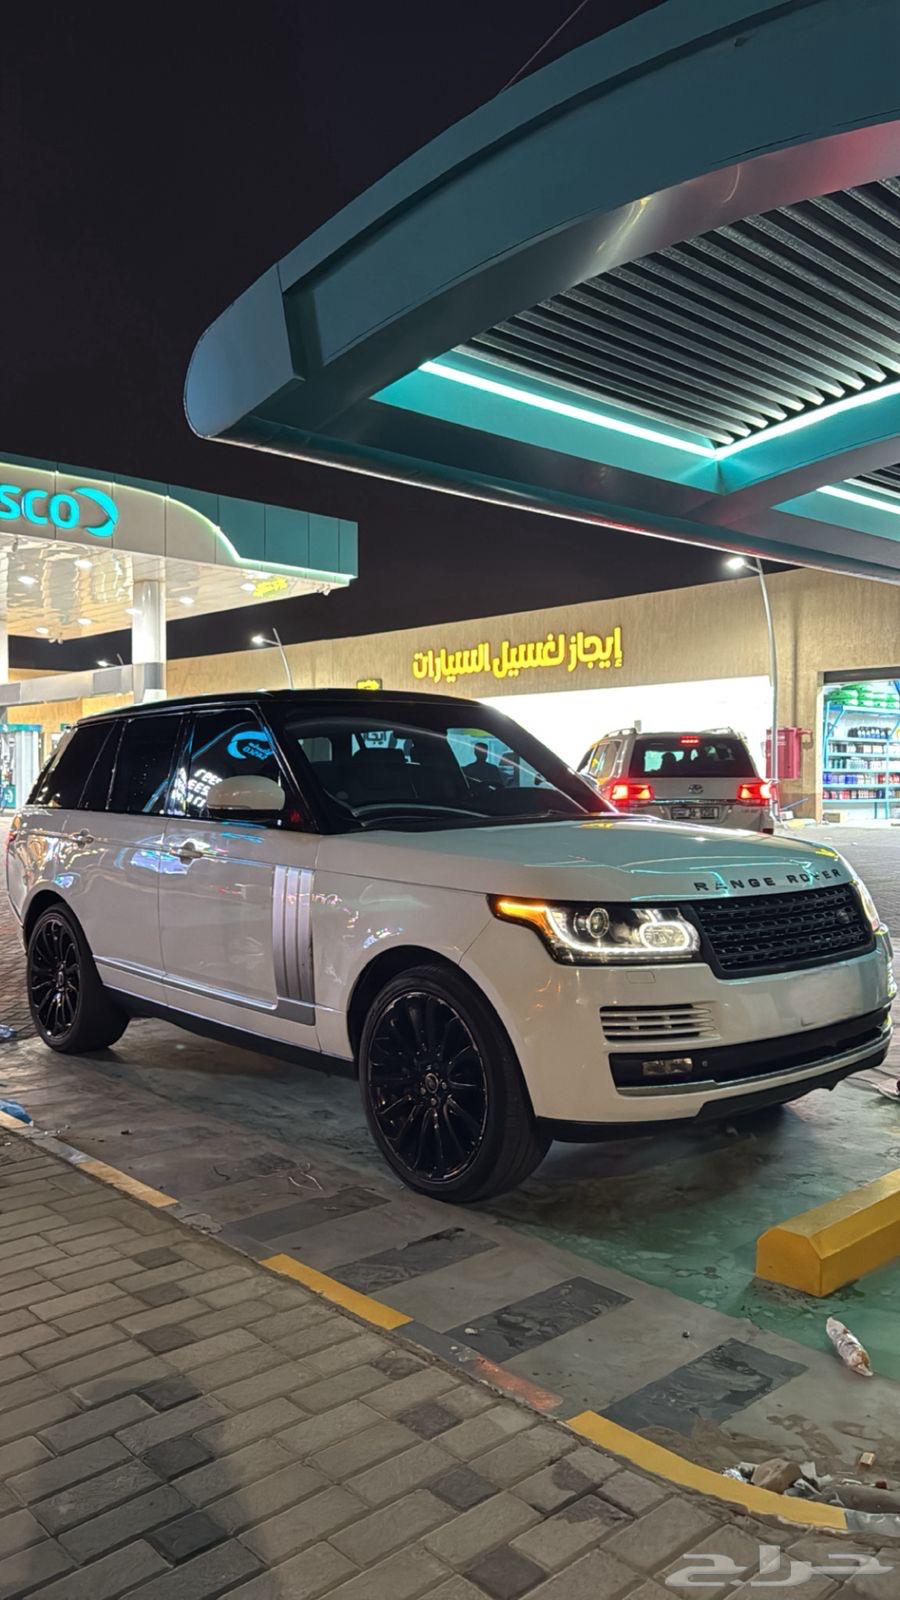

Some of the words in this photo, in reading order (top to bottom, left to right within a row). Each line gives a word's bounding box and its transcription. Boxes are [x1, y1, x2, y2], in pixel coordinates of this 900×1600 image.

[412, 642, 491, 683] السيارات
[492, 633, 566, 679] لغسيل
[567, 627, 623, 672] إيجاز
[693, 877, 776, 892] RANGE
[786, 868, 841, 885] ROVER
